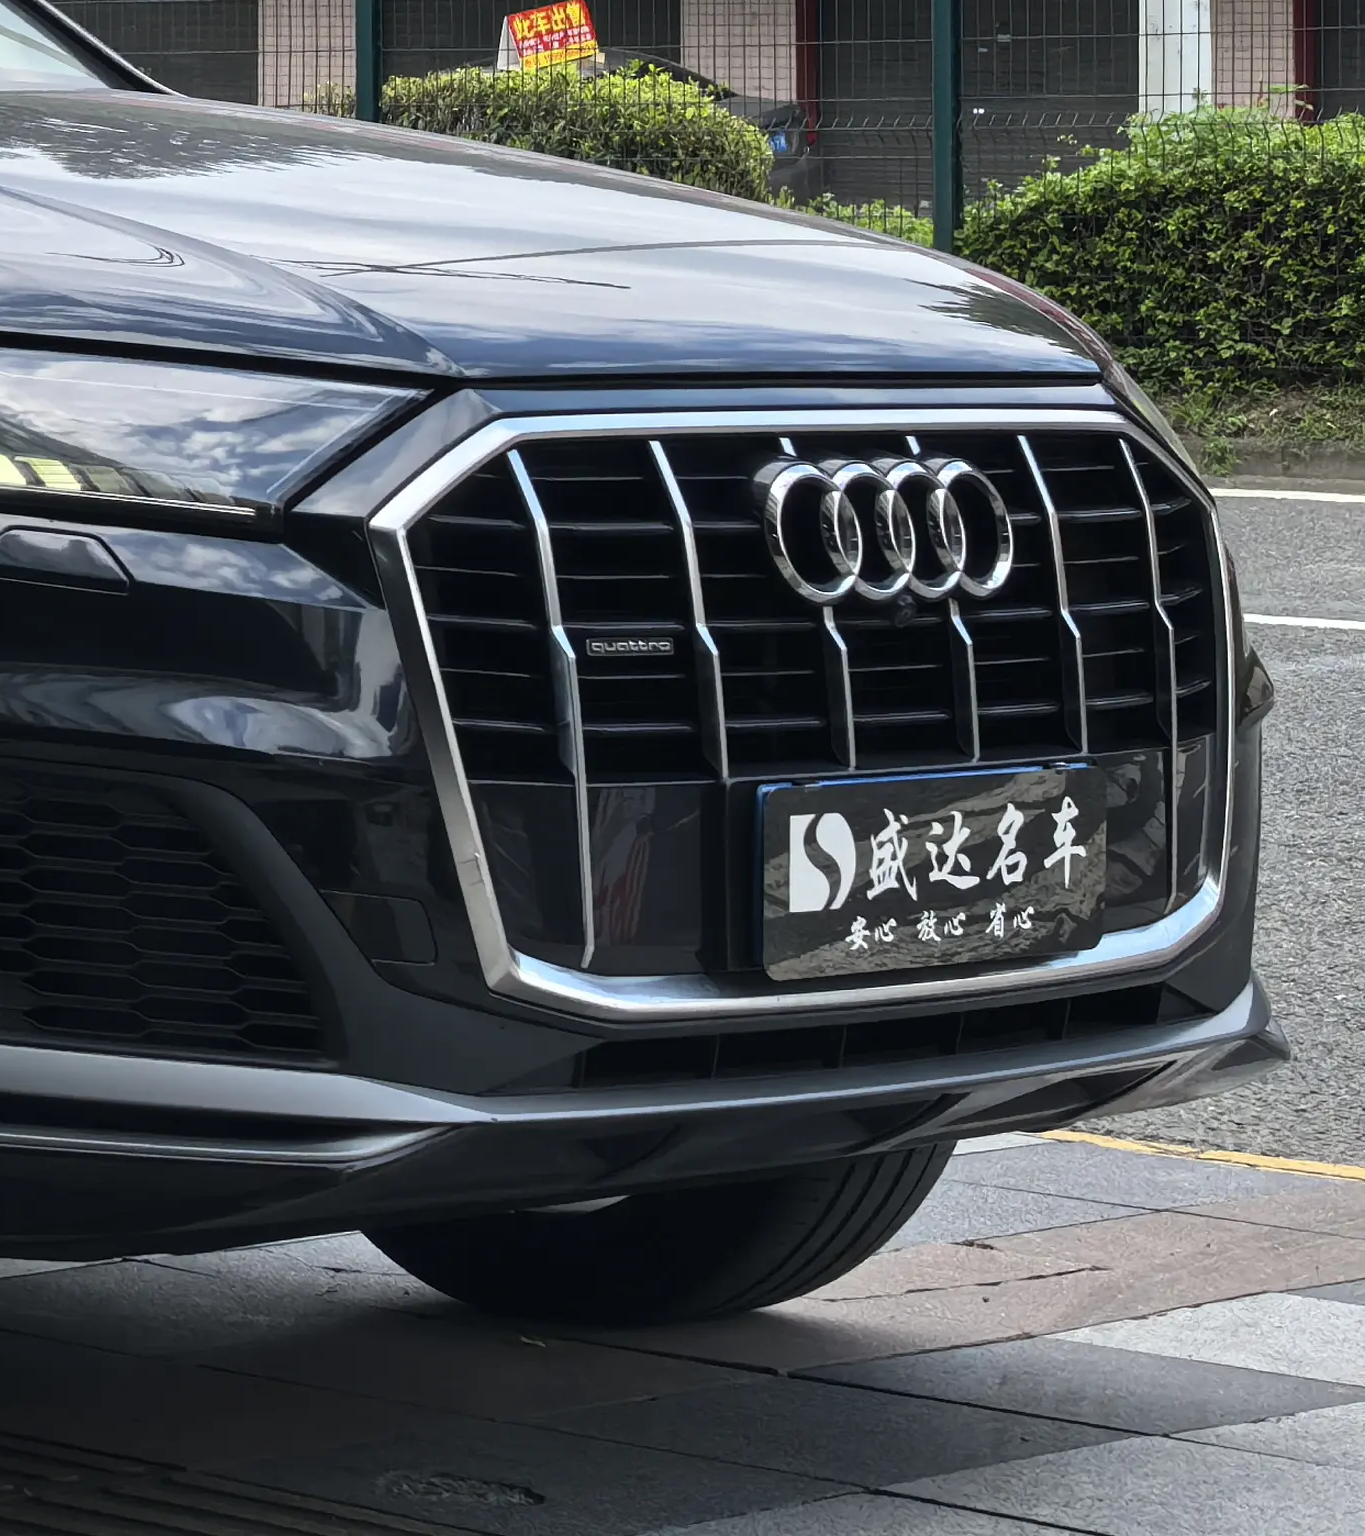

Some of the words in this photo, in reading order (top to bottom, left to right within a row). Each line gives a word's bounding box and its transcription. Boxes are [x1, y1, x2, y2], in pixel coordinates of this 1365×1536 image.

[591, 639, 671, 653] quattro
[866, 796, 1086, 901] 盛达名车
[845, 915, 897, 950] 安心
[917, 910, 966, 942] 放心
[985, 902, 1034, 938] 省心
